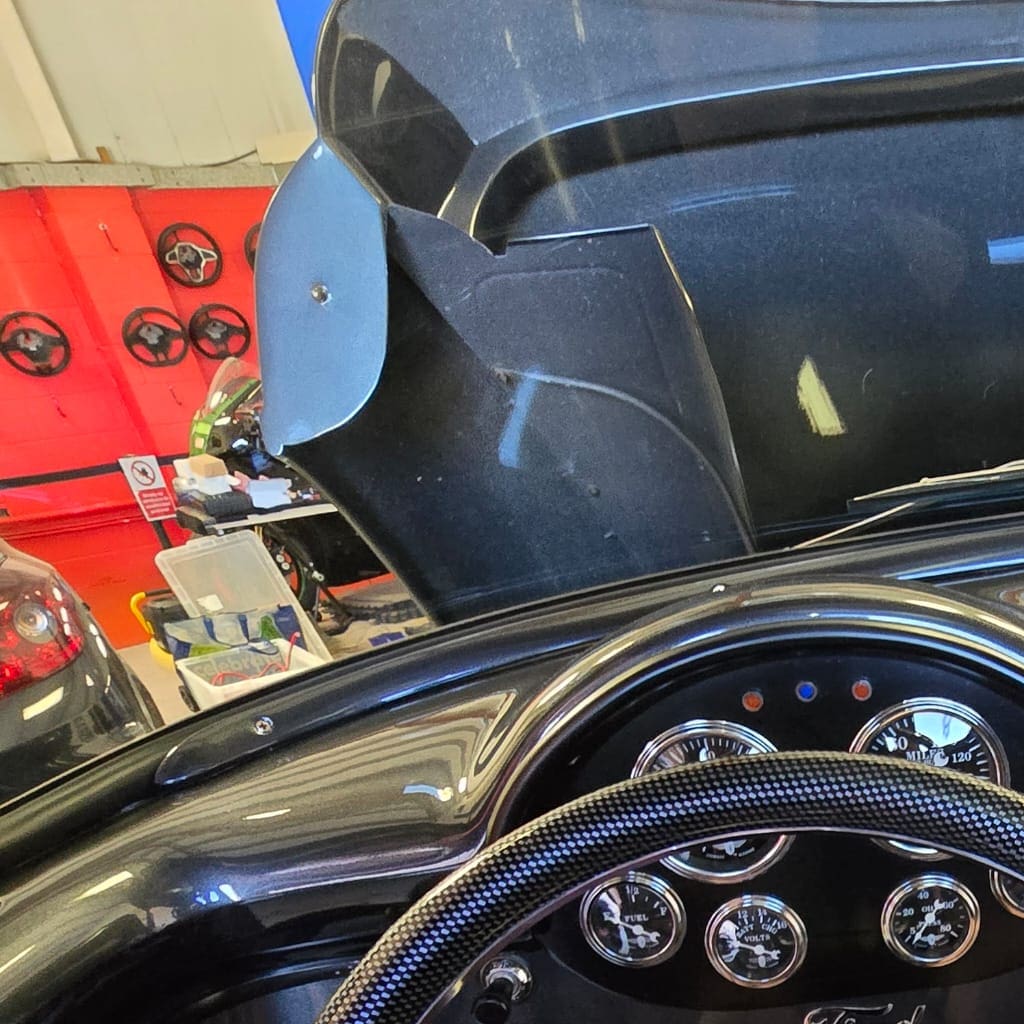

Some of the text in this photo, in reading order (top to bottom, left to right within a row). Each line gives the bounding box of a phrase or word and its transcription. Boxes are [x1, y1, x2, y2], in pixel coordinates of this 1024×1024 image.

[951, 752, 972, 763] 120
[917, 891, 930, 900] 40
[902, 907, 915, 917] 20
[623, 913, 649, 922] FUEL
